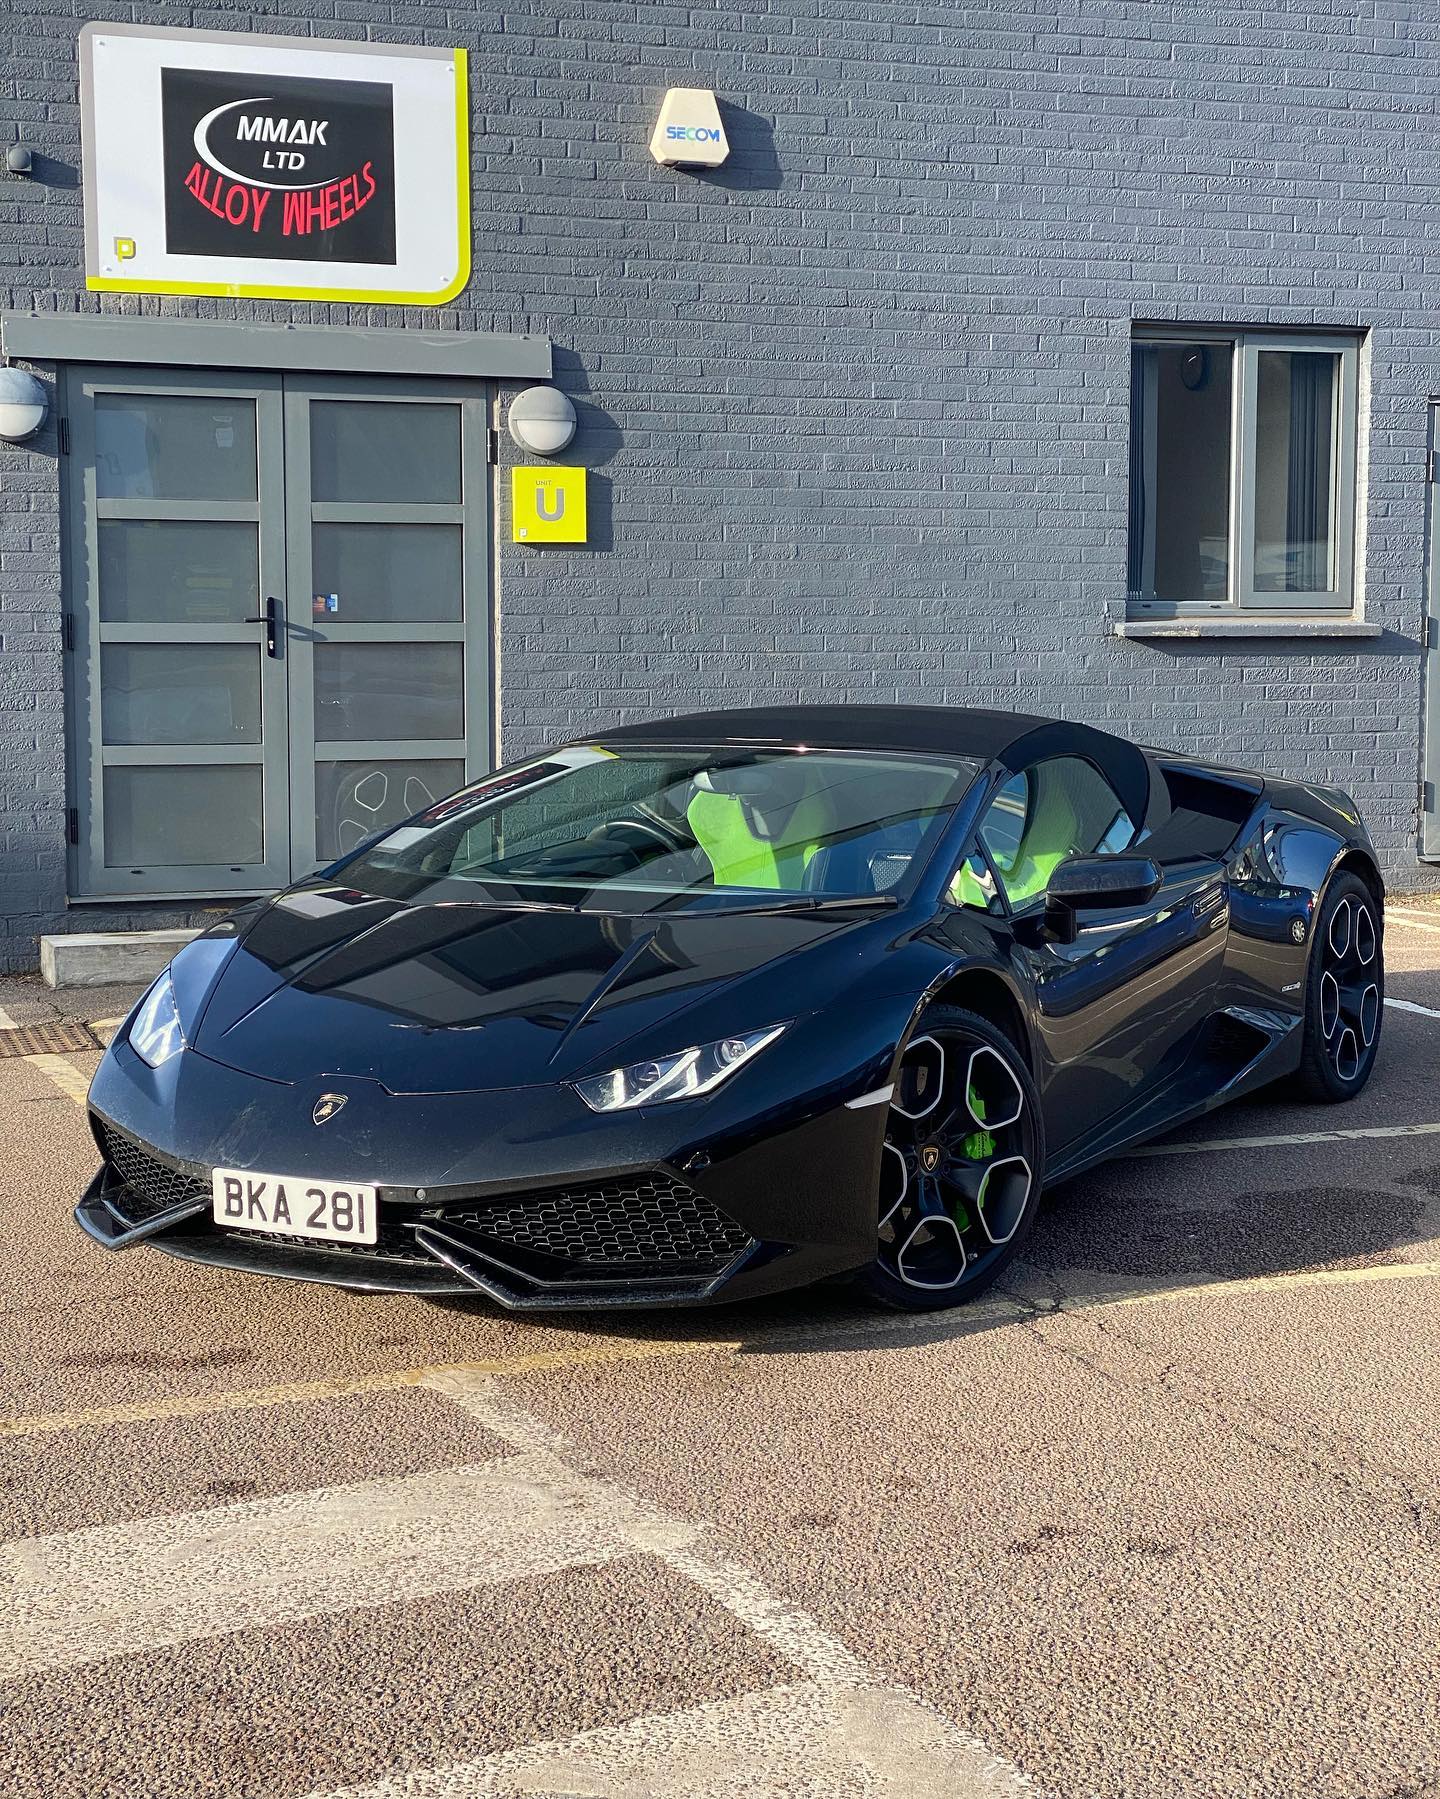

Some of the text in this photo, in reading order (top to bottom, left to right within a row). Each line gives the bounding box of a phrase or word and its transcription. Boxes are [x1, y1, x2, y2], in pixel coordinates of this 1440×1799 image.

[236, 115, 329, 146] MMAK
[666, 126, 720, 142] SECOM
[262, 150, 306, 171] LTD
[184, 161, 377, 236] ALLOY WHEELS
[536, 488, 565, 522] U
[223, 1176, 365, 1234] BKA 281
